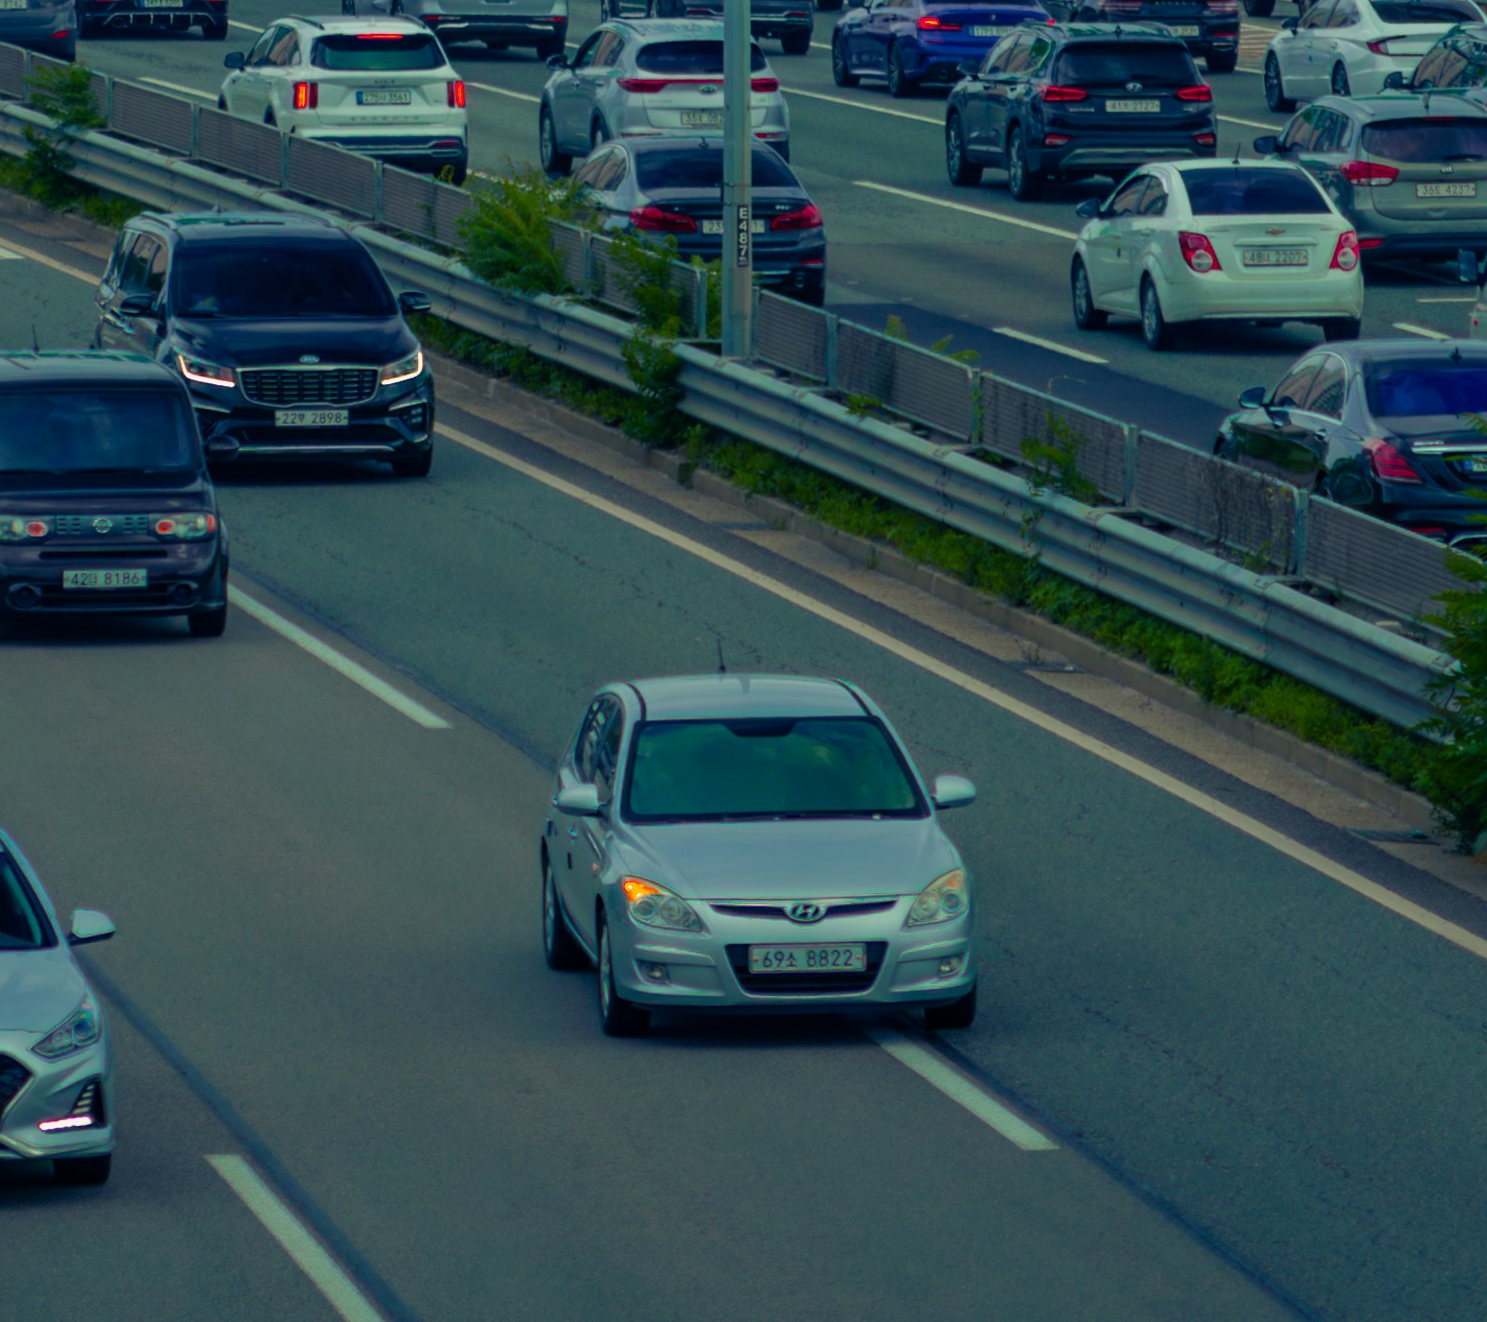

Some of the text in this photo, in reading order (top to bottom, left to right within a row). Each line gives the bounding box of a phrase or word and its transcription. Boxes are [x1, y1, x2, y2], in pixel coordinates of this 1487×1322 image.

[1445, 183, 1470, 194] 4237
[1276, 250, 1301, 261] 2207
[311, 412, 342, 423] 2898
[104, 571, 139, 584] 8186
[762, 949, 853, 968] 69소 8822
